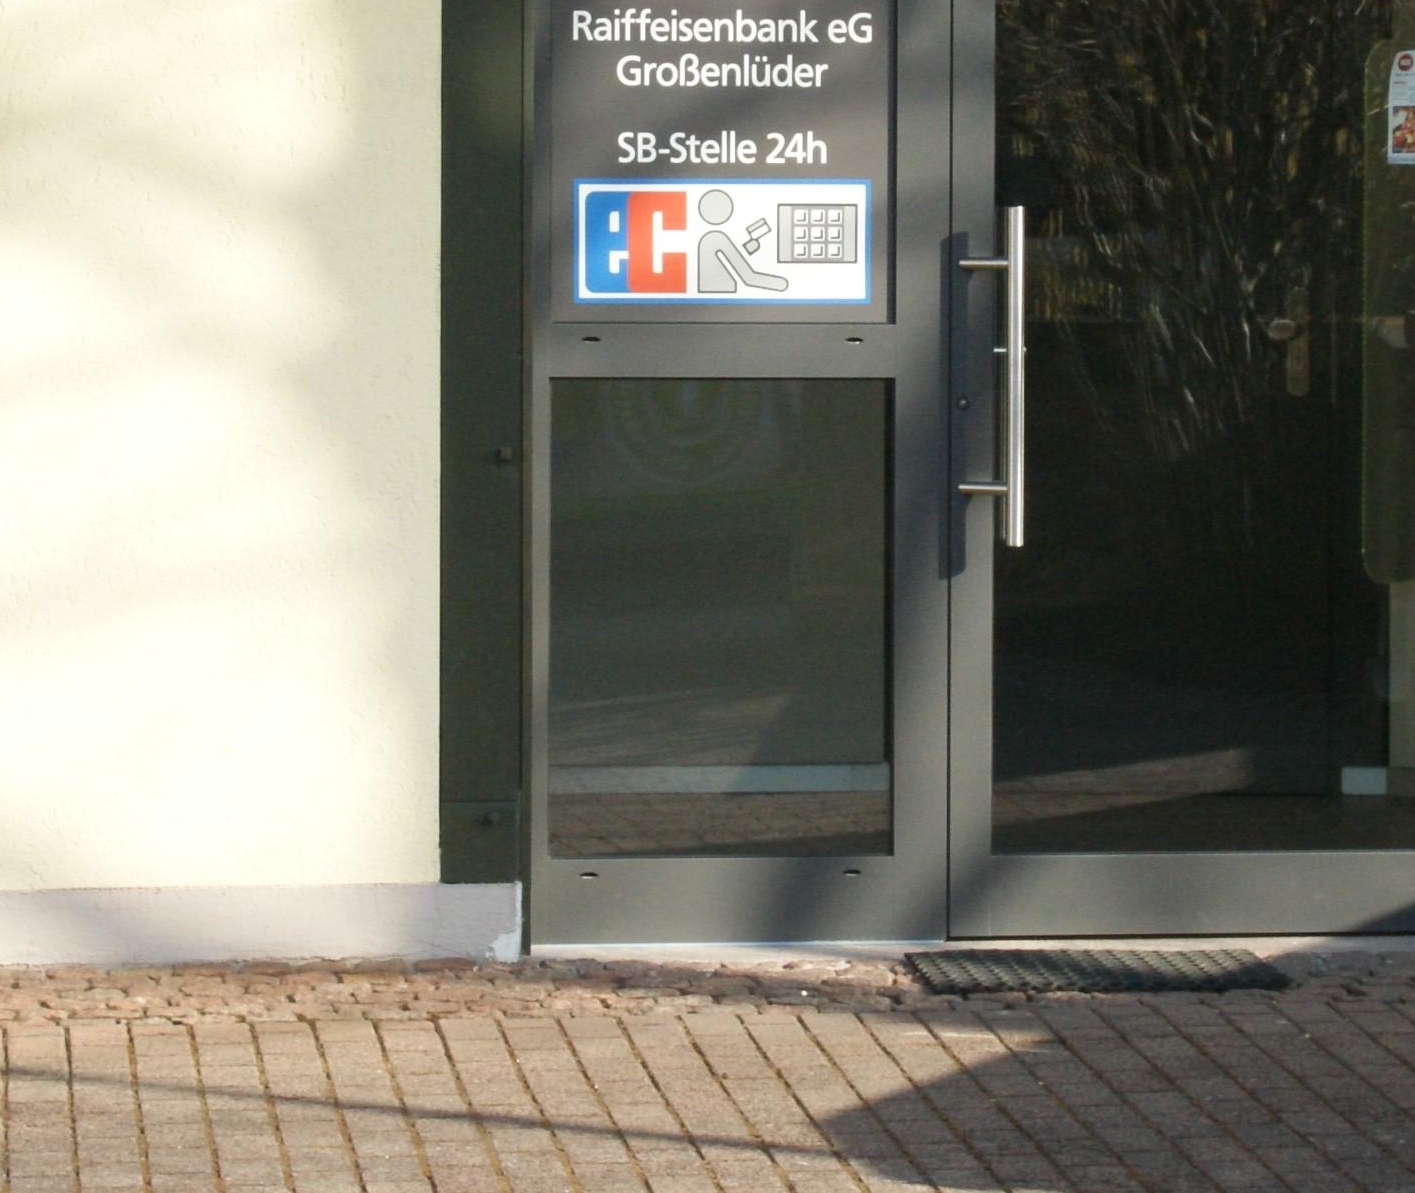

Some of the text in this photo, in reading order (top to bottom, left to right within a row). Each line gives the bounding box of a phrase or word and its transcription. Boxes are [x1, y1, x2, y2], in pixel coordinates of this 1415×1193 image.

[572, 8, 873, 45] Raiffeisenbank eG
[616, 53, 829, 89] Großenlüder
[617, 131, 828, 165] SB-Stelle 24h
